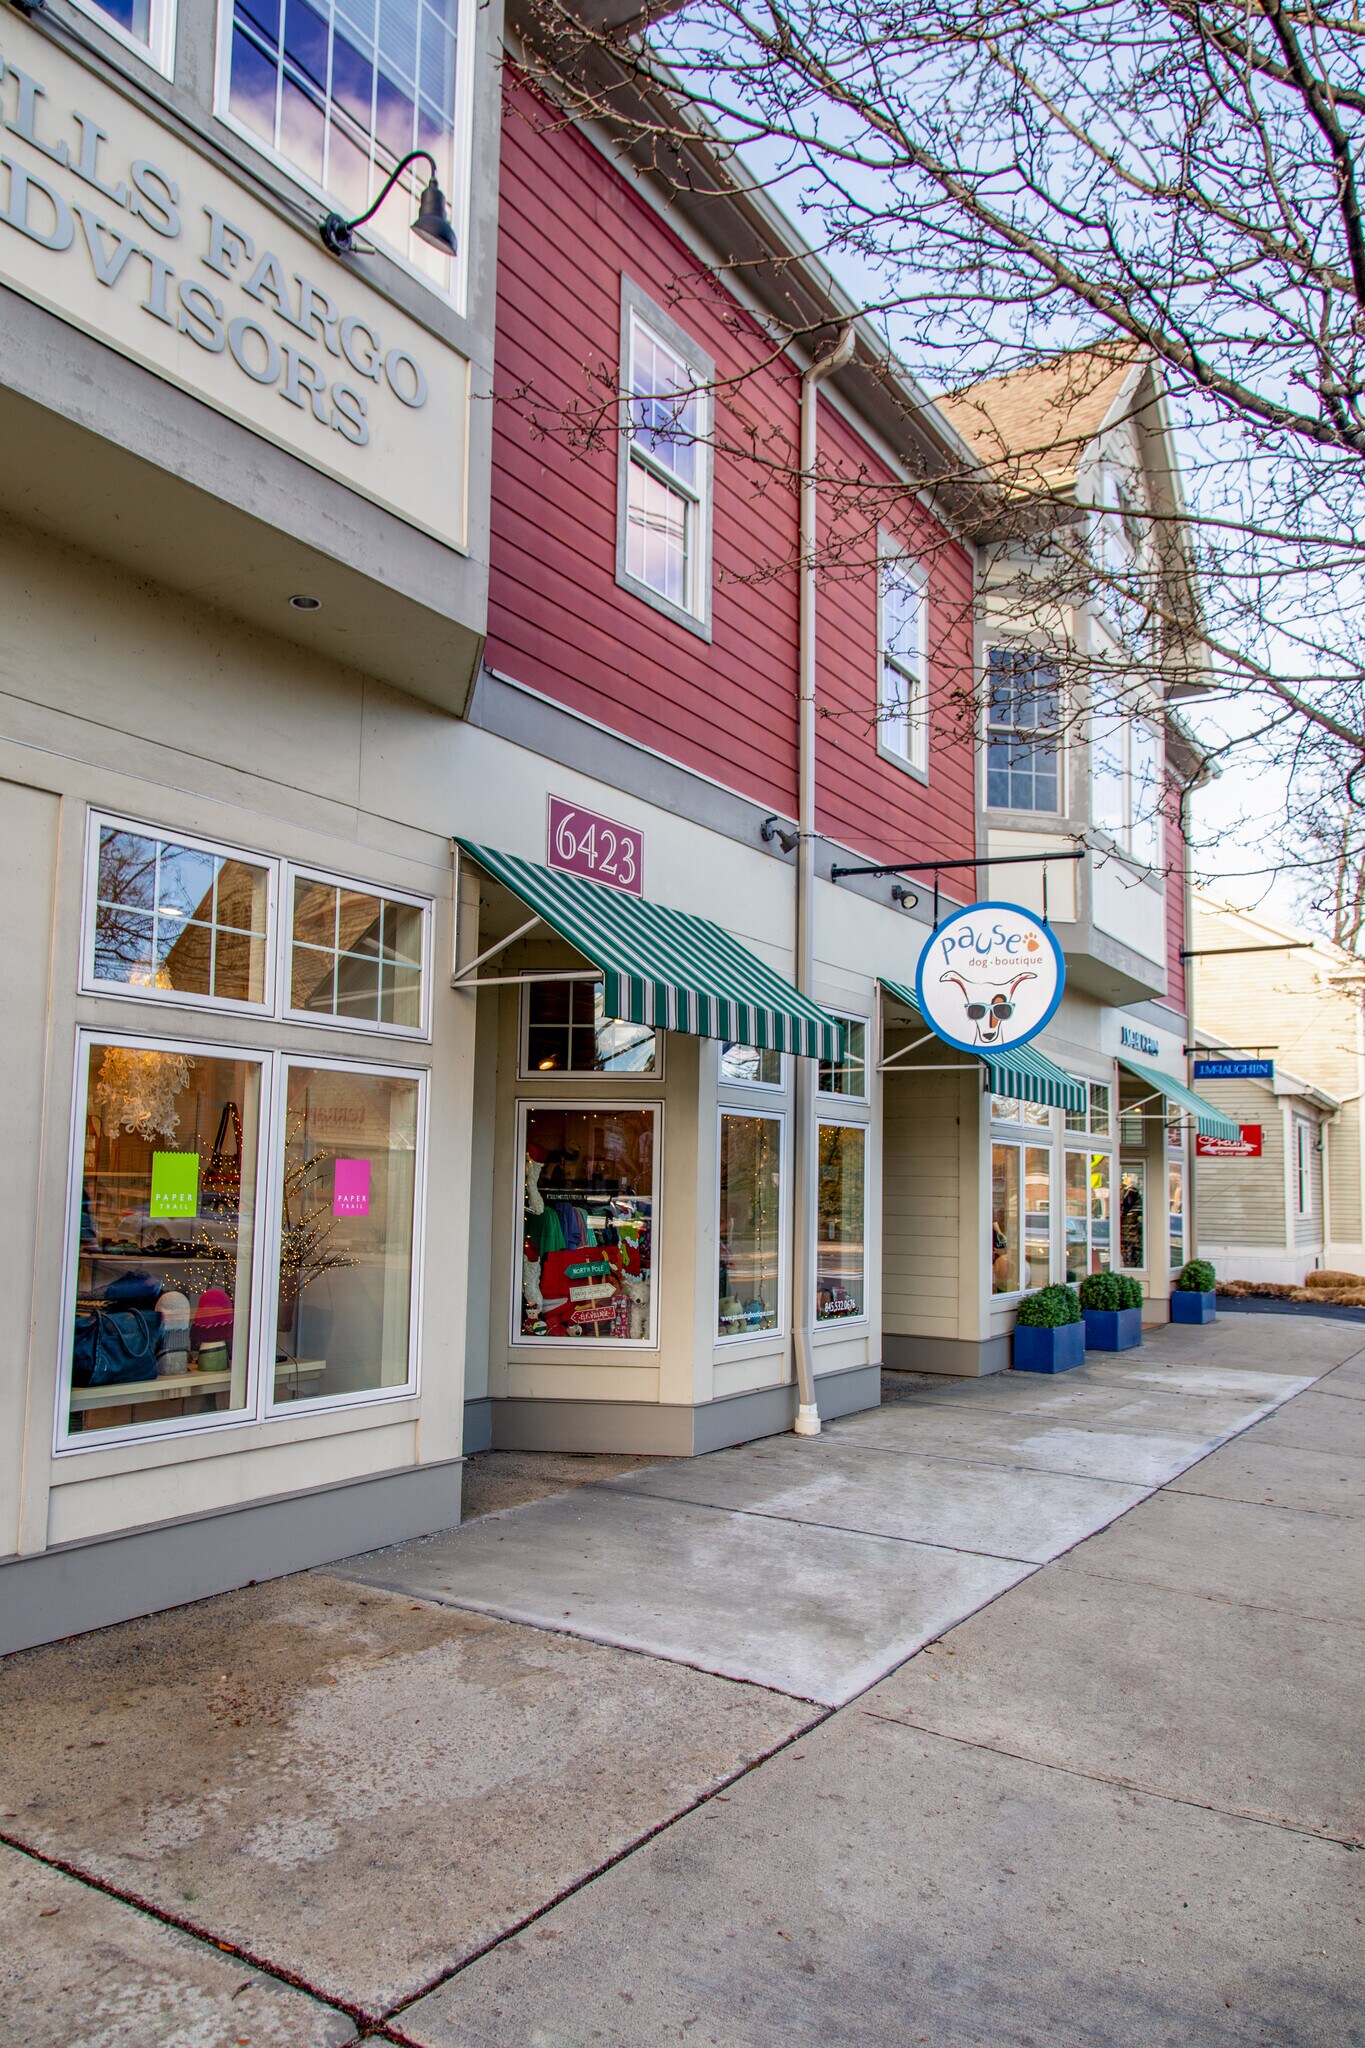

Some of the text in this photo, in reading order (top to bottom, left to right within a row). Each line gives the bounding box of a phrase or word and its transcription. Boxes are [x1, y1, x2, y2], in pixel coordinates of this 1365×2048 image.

[0, 54, 428, 408] LLS FARGO
[556, 812, 635, 884] 6423
[940, 924, 1021, 965] pause
[968, 956, 1043, 969] dog boutique
[155, 1193, 192, 1201] PAPER
[337, 1194, 367, 1202] PAPER
[572, 1266, 591, 1275] NORTH
[589, 1310, 609, 1319] VILLAGE
